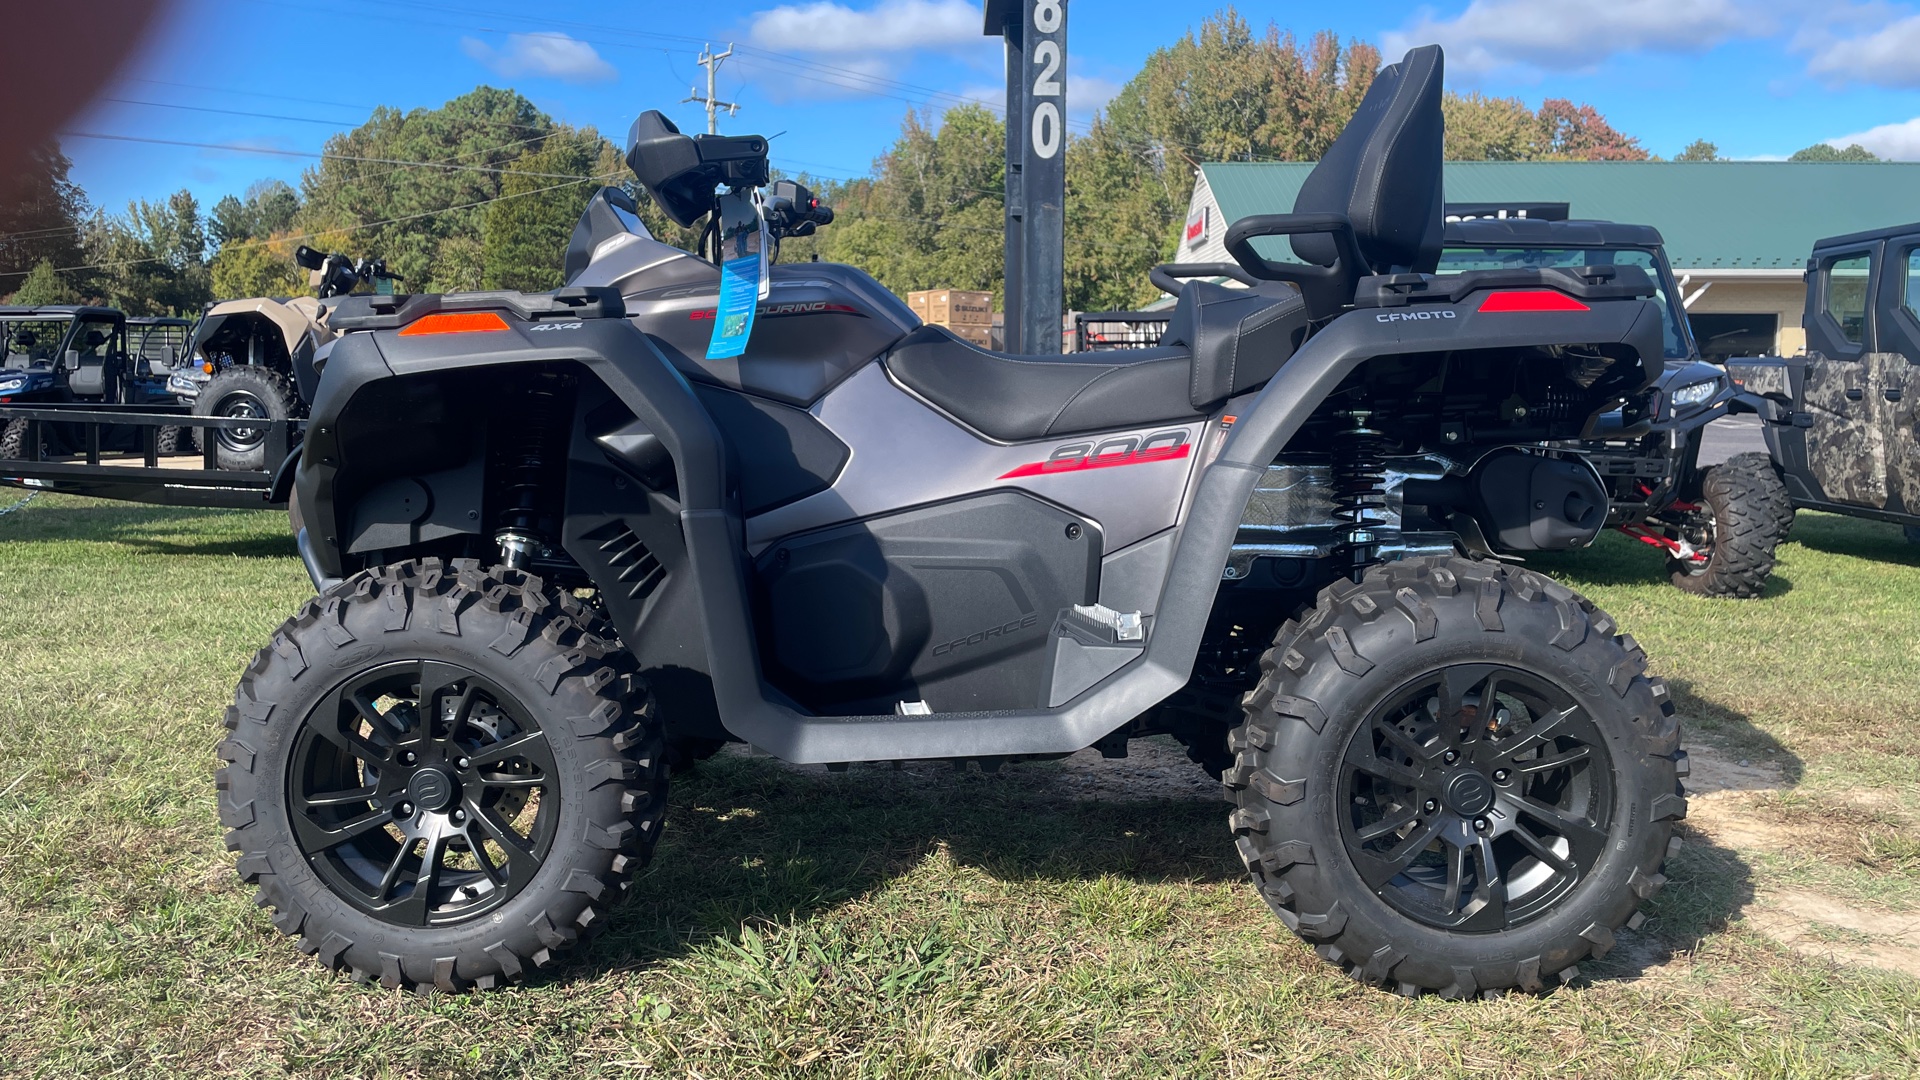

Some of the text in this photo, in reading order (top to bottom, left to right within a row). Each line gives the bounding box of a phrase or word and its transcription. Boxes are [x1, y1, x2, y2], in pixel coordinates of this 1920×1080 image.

[1032, 0, 1062, 159] 820
[755, 302, 827, 316] OURING
[1376, 310, 1456, 323] CFMOTO
[1041, 428, 1191, 471] 800
[932, 611, 1038, 657] CFORCE
